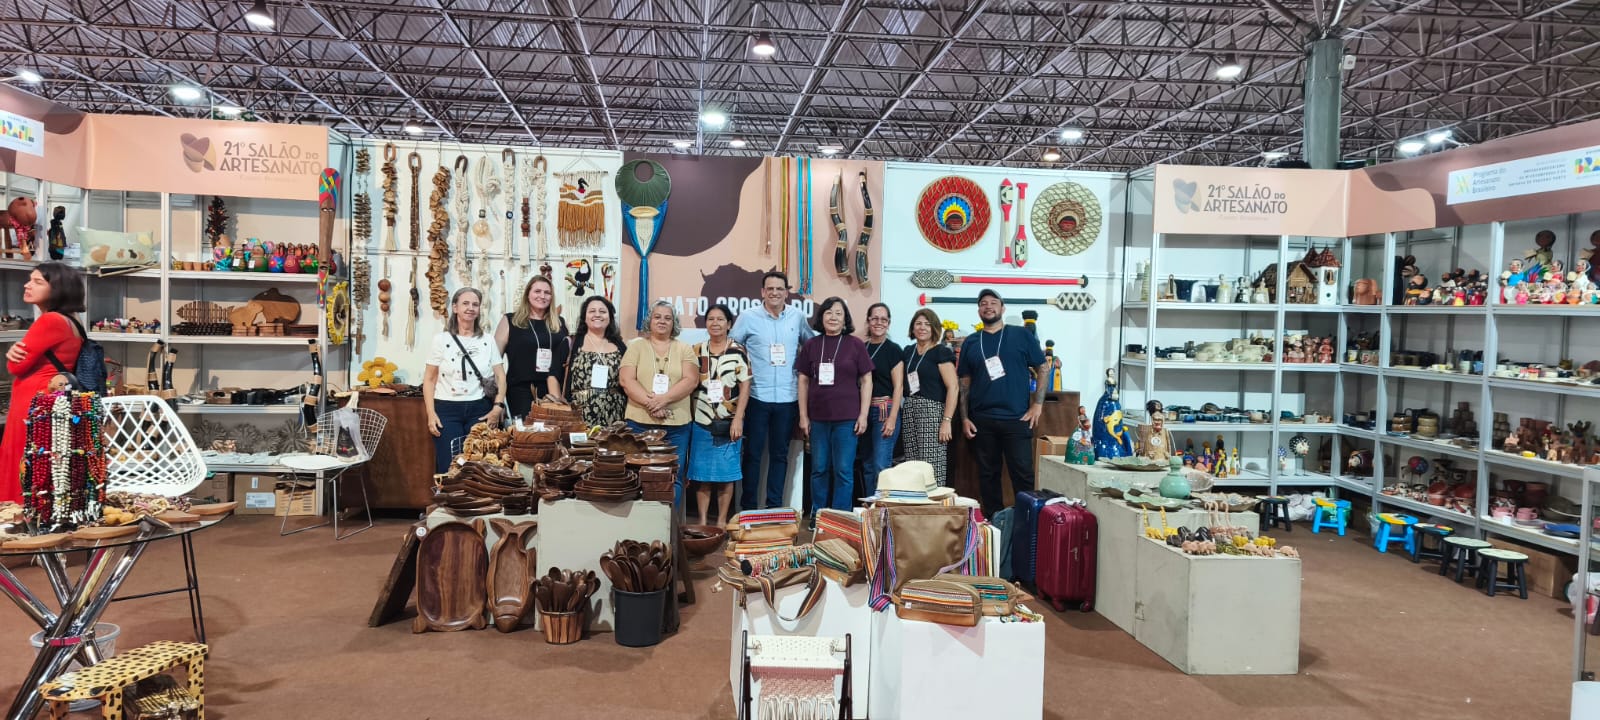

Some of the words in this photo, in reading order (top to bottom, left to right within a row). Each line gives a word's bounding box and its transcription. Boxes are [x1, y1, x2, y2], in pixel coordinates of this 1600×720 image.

[248, 141, 301, 159] SALÃO
[305, 152, 320, 160] DO
[219, 157, 322, 176] ARTESANATO
[1227, 184, 1271, 200] SALÃO
[1274, 192, 1286, 200] DO
[1203, 199, 1288, 214] ARTESANATO
